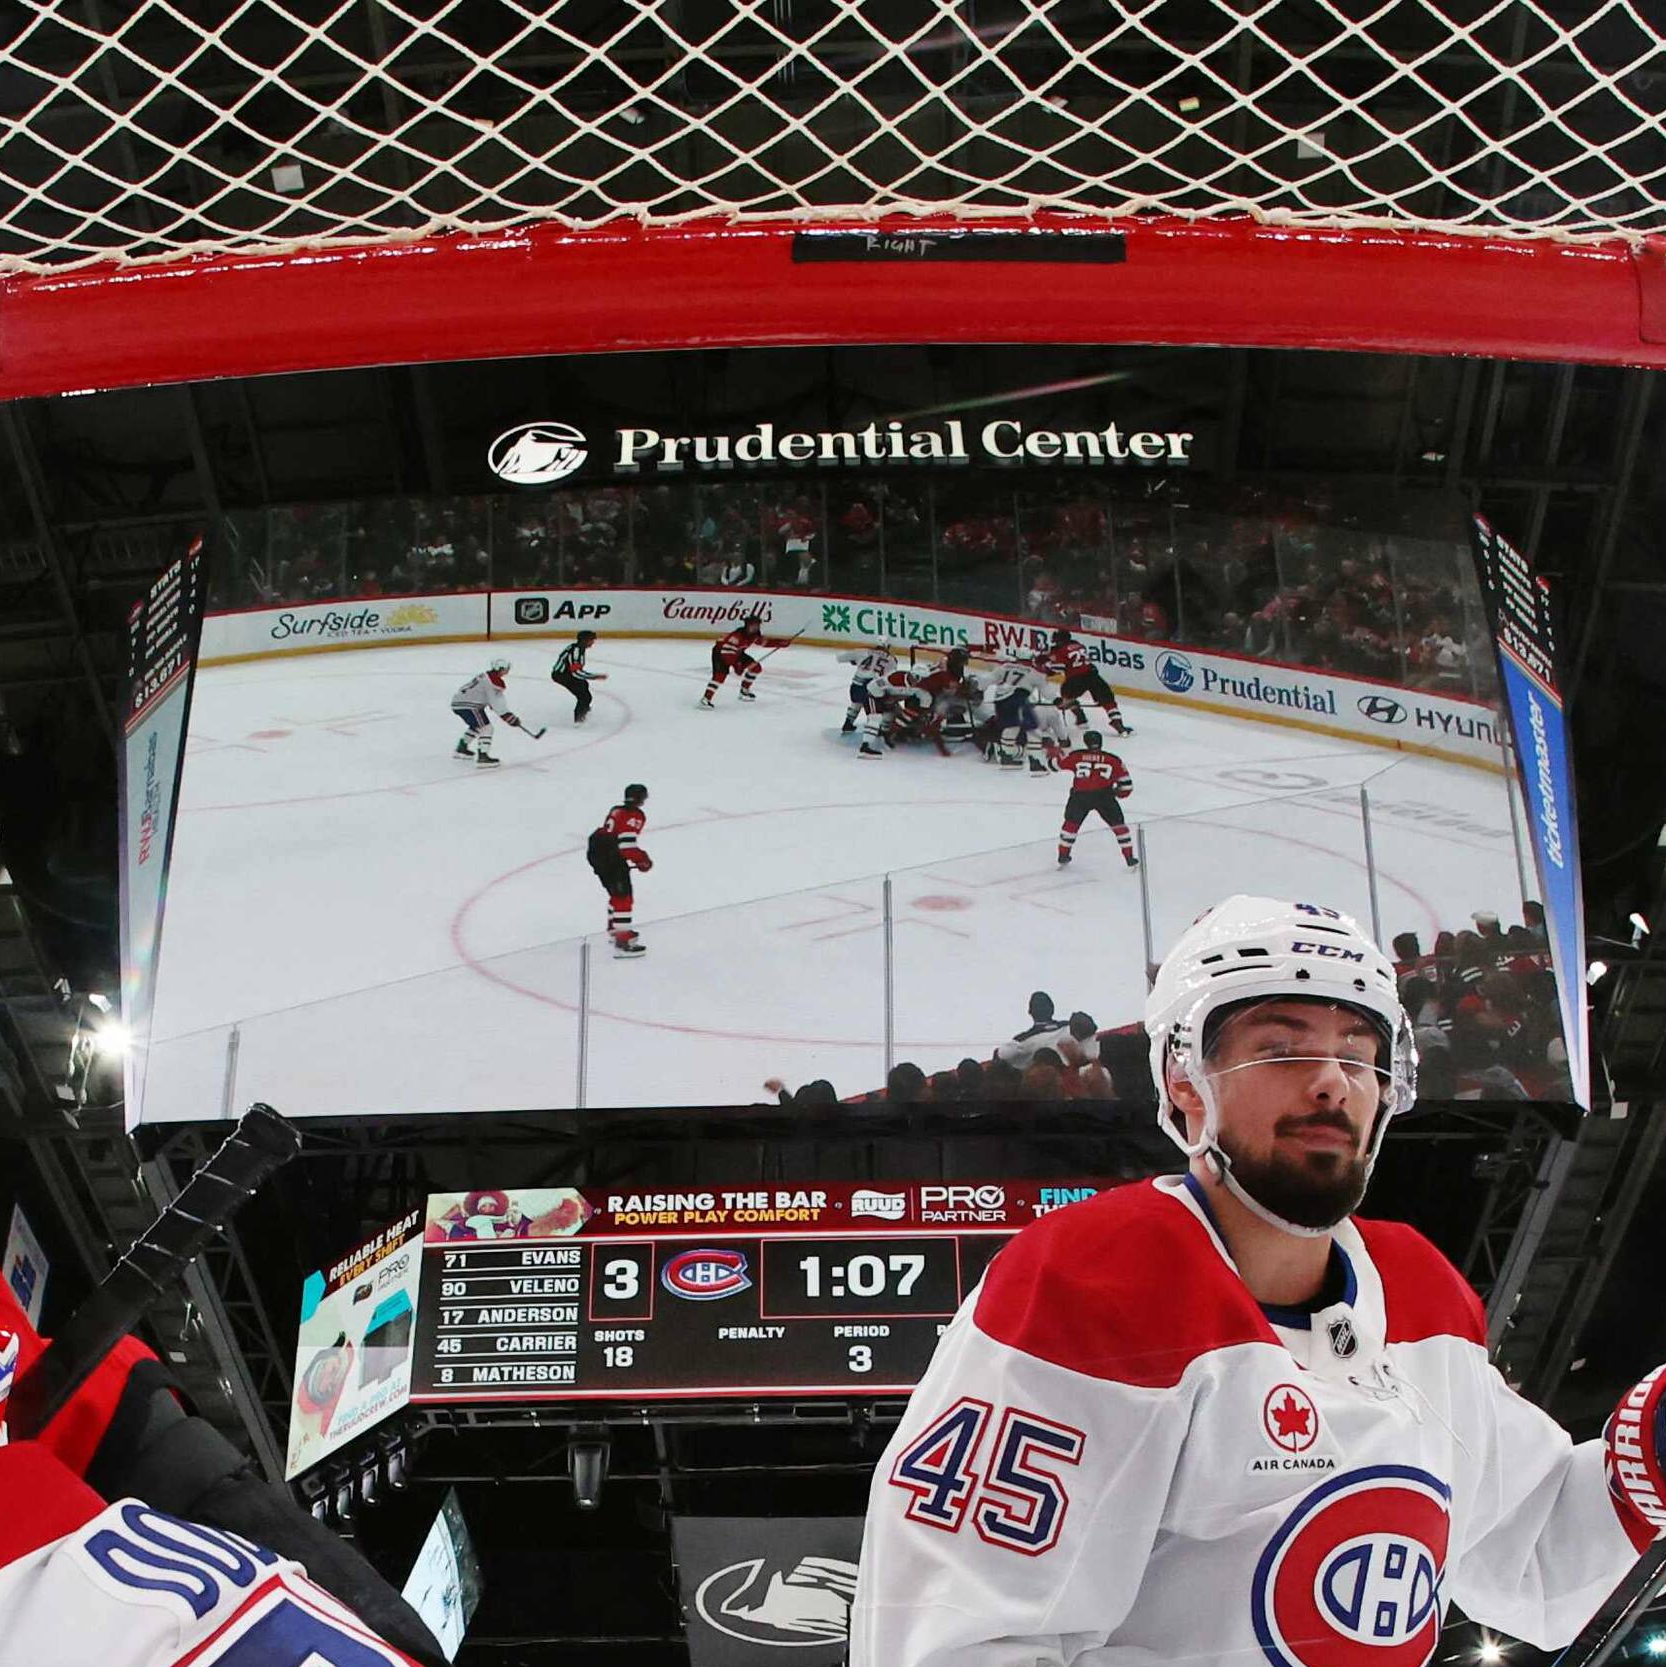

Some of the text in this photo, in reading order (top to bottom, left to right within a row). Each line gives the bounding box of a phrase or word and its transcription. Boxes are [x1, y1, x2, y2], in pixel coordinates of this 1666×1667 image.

[866, 236, 936, 256] RIGHT
[614, 420, 1194, 468] Prudential Center
[271, 608, 380, 639] Surfside
[857, 607, 969, 648] Citizens
[1200, 666, 1337, 716] Prudential
[1528, 690, 1564, 869] ticketmaster
[1290, 941, 1364, 963] CCM
[607, 1191, 827, 1213] RAISING THE BAR
[851, 1196, 906, 1213] RUUD
[921, 1186, 1006, 1209] PRO
[614, 1209, 822, 1225] POWER PLAY COMFORT
[921, 1210, 1006, 1222] PARTNER
[329, 1210, 420, 1283] RELIABLE HEAT
[339, 1233, 406, 1288] EVERY SHIFT
[444, 1250, 581, 1268] 71 EVANS
[603, 1259, 640, 1300] 3
[799, 1255, 925, 1298] 1:07
[441, 1278, 580, 1297] 90 VELENO
[441, 1307, 578, 1325] 17 ANDERSON
[594, 1329, 645, 1342] SHOTS
[717, 1326, 785, 1340] PENALTY
[833, 1325, 890, 1338] PERIOD
[437, 1336, 577, 1353] 45 CARRIER
[602, 1346, 633, 1367] 18
[848, 1345, 873, 1373] 3
[441, 1365, 576, 1383] 8 MATHESON
[1252, 1457, 1336, 1472] AIR CANADA
[889, 1397, 1087, 1557] 45
